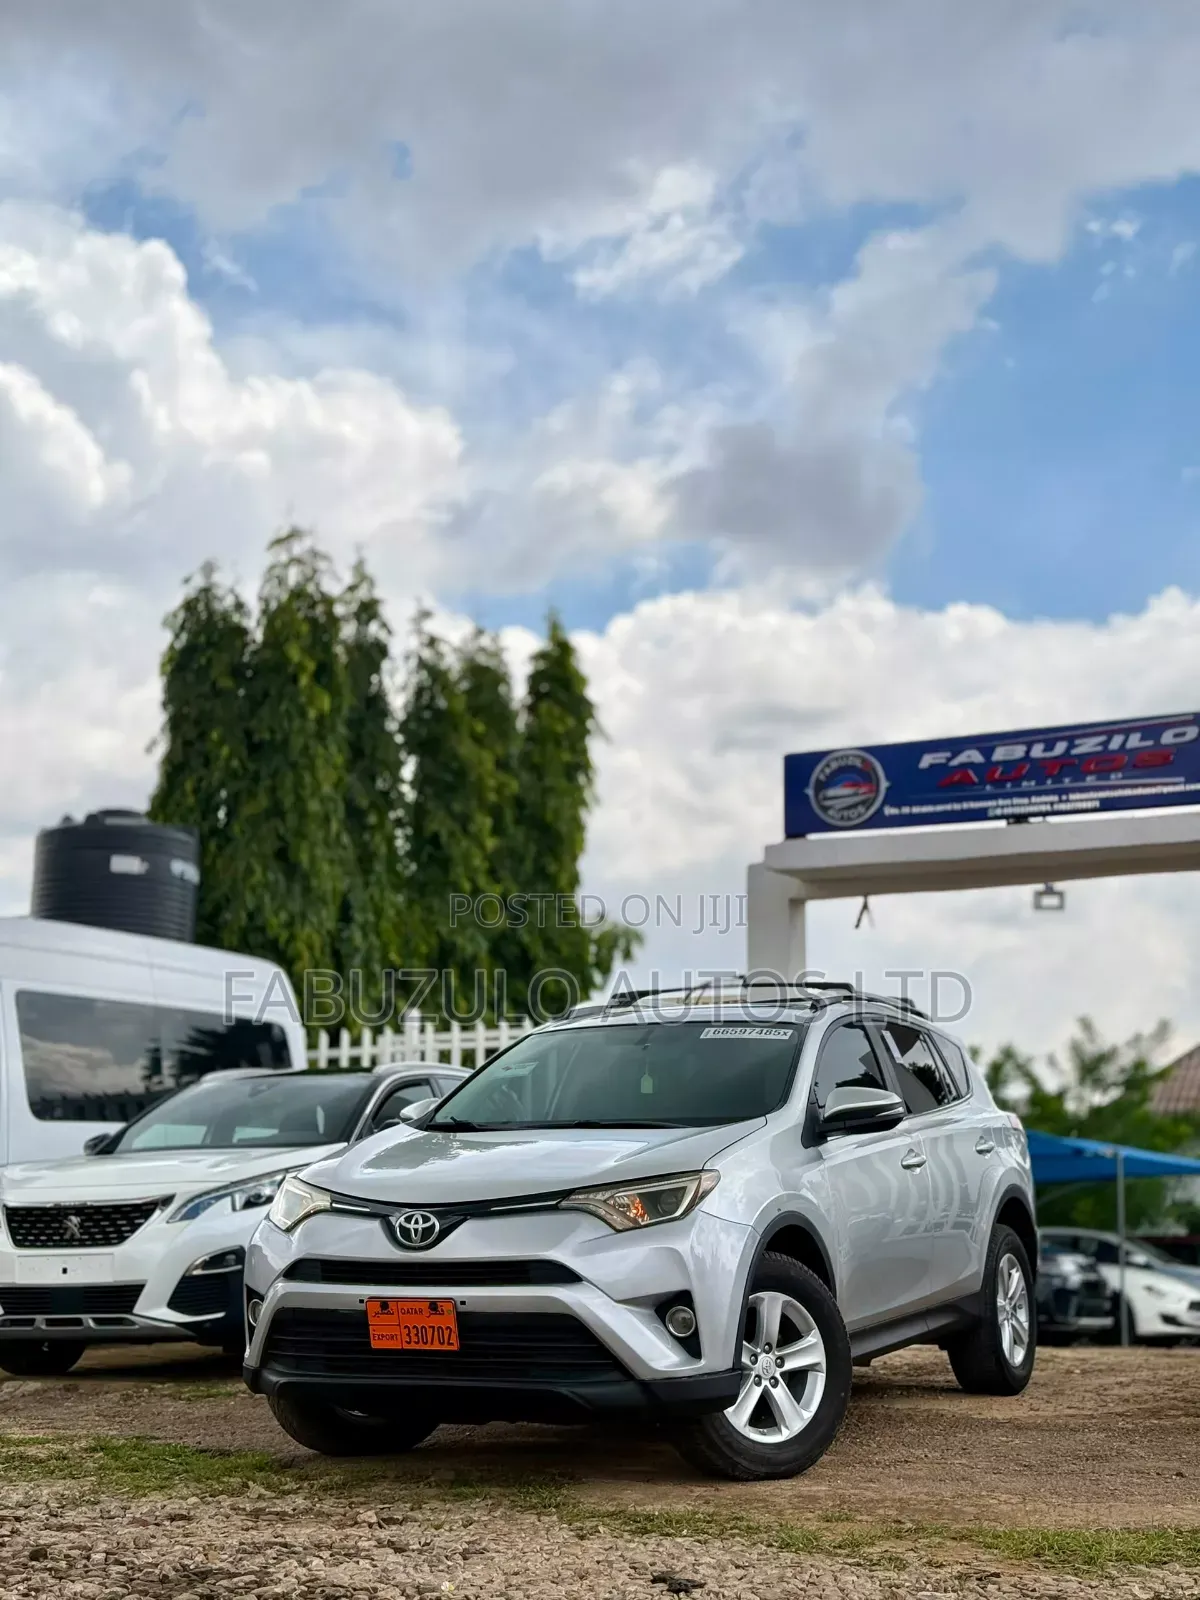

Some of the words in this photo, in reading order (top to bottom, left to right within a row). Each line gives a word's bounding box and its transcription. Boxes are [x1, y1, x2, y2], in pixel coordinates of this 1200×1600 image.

[918, 725, 1199, 769] FABUZILO
[937, 748, 1176, 788] AUTOS
[400, 1307, 423, 1315] QATAR
[373, 1333, 398, 1341] EXPORT
[404, 1325, 454, 1346] 330702
